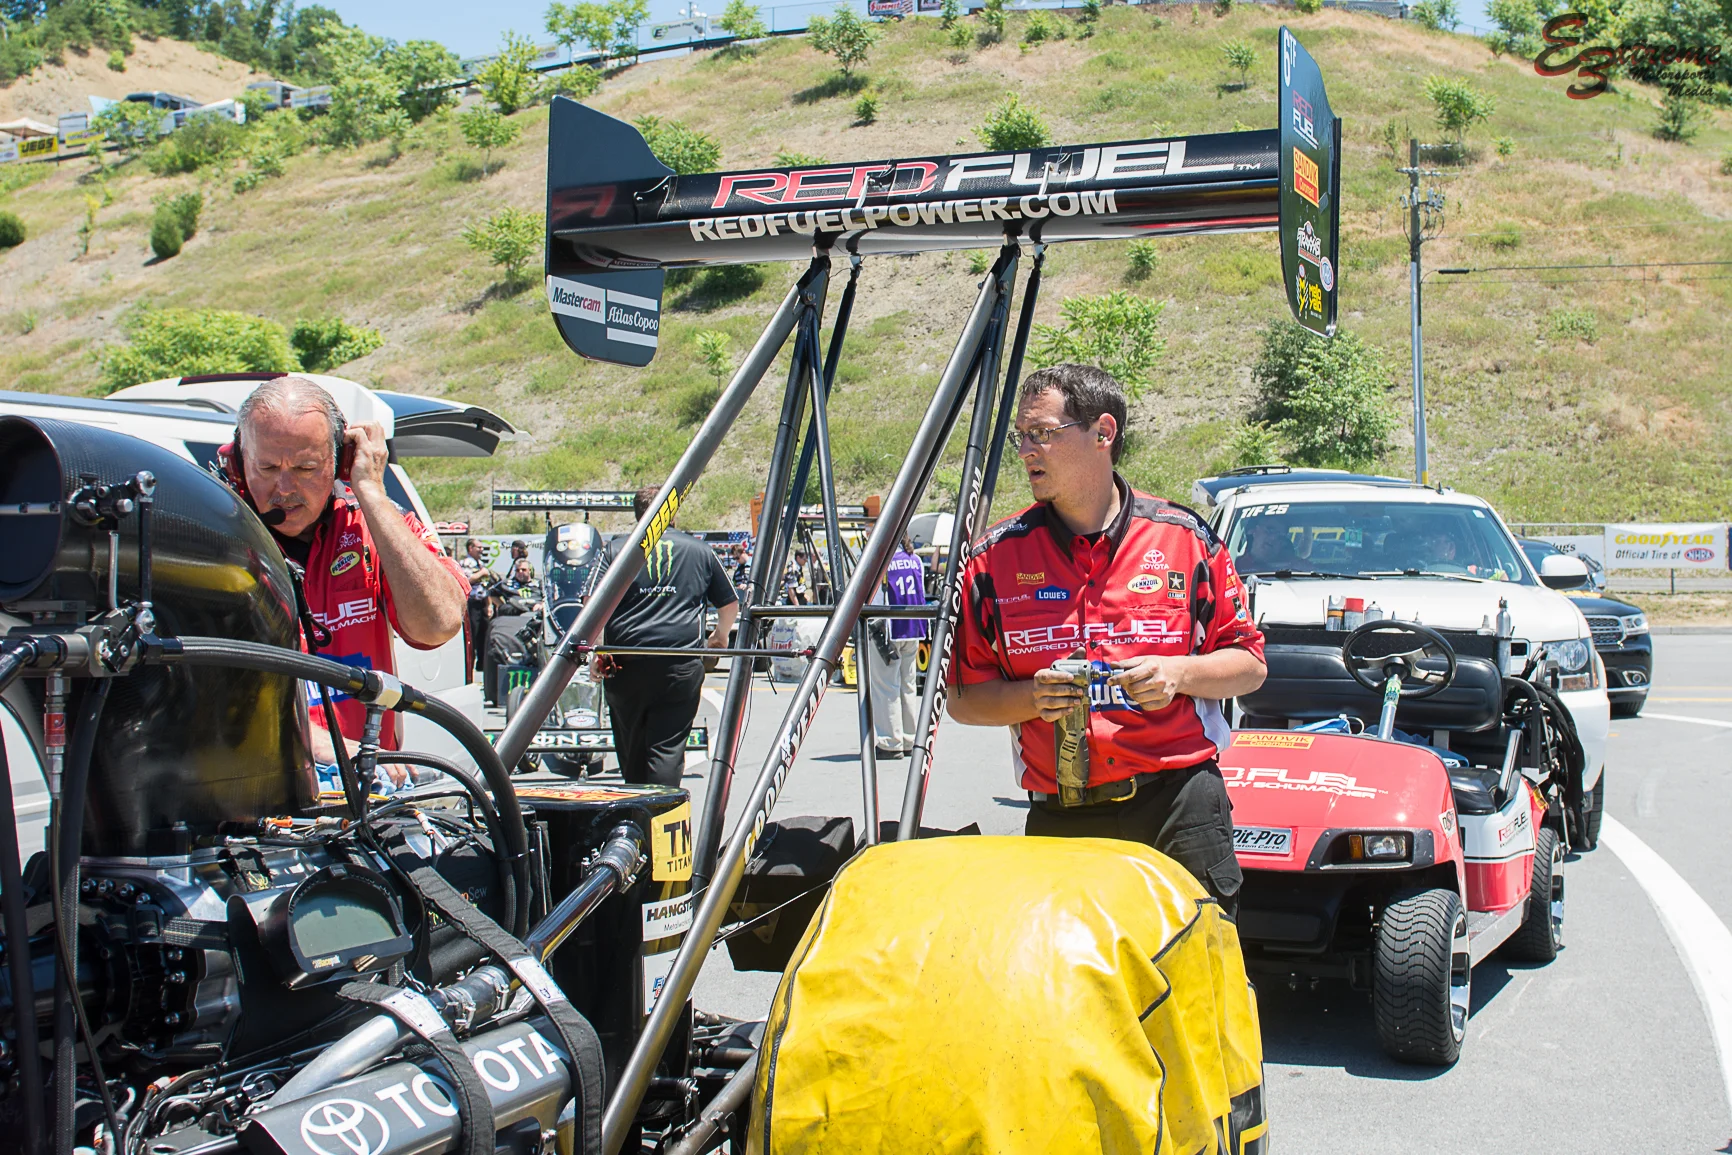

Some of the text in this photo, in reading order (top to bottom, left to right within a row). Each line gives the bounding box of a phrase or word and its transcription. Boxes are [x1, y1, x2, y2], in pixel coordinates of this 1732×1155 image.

[21, 137, 54, 153] JEGS
[690, 190, 1117, 241] REDFUELPOWER.COM
[552, 286, 601, 313] Mastercam
[607, 306, 658, 331] Atlas Copco
[1265, 504, 1290, 516] 25
[1552, 542, 1576, 553] lugs
[1615, 531, 1714, 548] GOODYEAR
[1615, 549, 1712, 561] Official Tire of NHRA
[331, 553, 355, 574] PENNZOIL
[887, 559, 919, 571] MEDIA
[896, 575, 917, 596] 12
[1132, 579, 1159, 588] PENNZOIL
[1038, 591, 1067, 599] LOWE'S
[1007, 636, 1183, 656] POWERED BY SCHUMACHER
[533, 730, 614, 746] ONST
[1240, 734, 1311, 743] SANDVIK
[1252, 781, 1376, 799] SCHUMACHER
[1232, 829, 1287, 845] Pit-Pro
[375, 1031, 571, 1129] TOOTA
